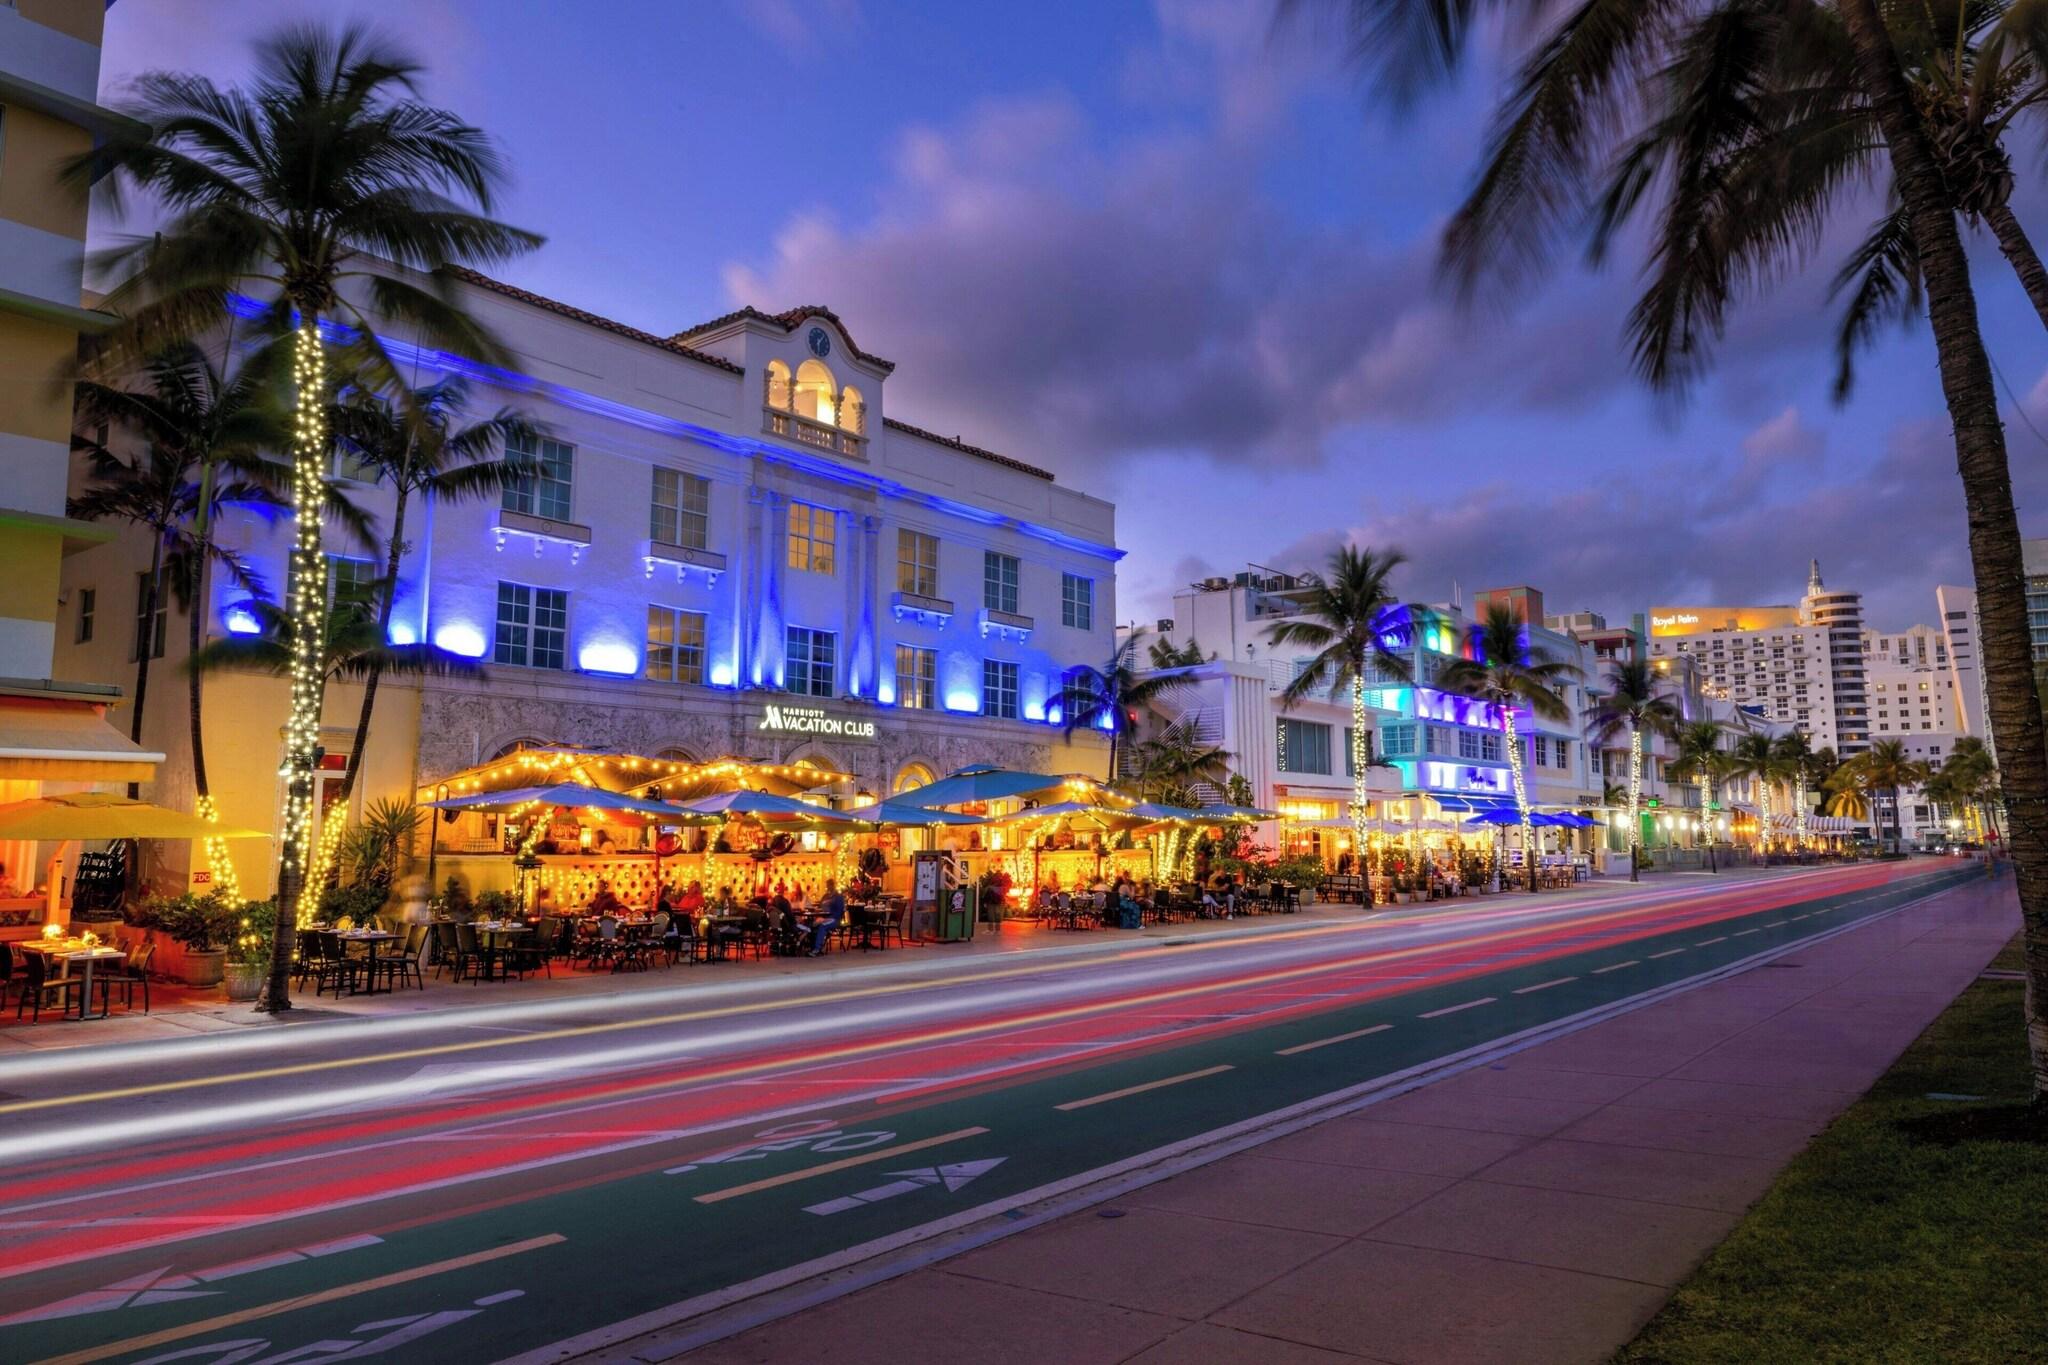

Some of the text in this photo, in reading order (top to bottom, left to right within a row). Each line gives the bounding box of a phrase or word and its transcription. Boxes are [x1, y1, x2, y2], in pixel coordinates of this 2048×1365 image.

[1653, 614, 1698, 629] Royal Palm
[783, 707, 825, 718] MARRIOTT
[783, 715, 874, 737] VACATION CLUB
